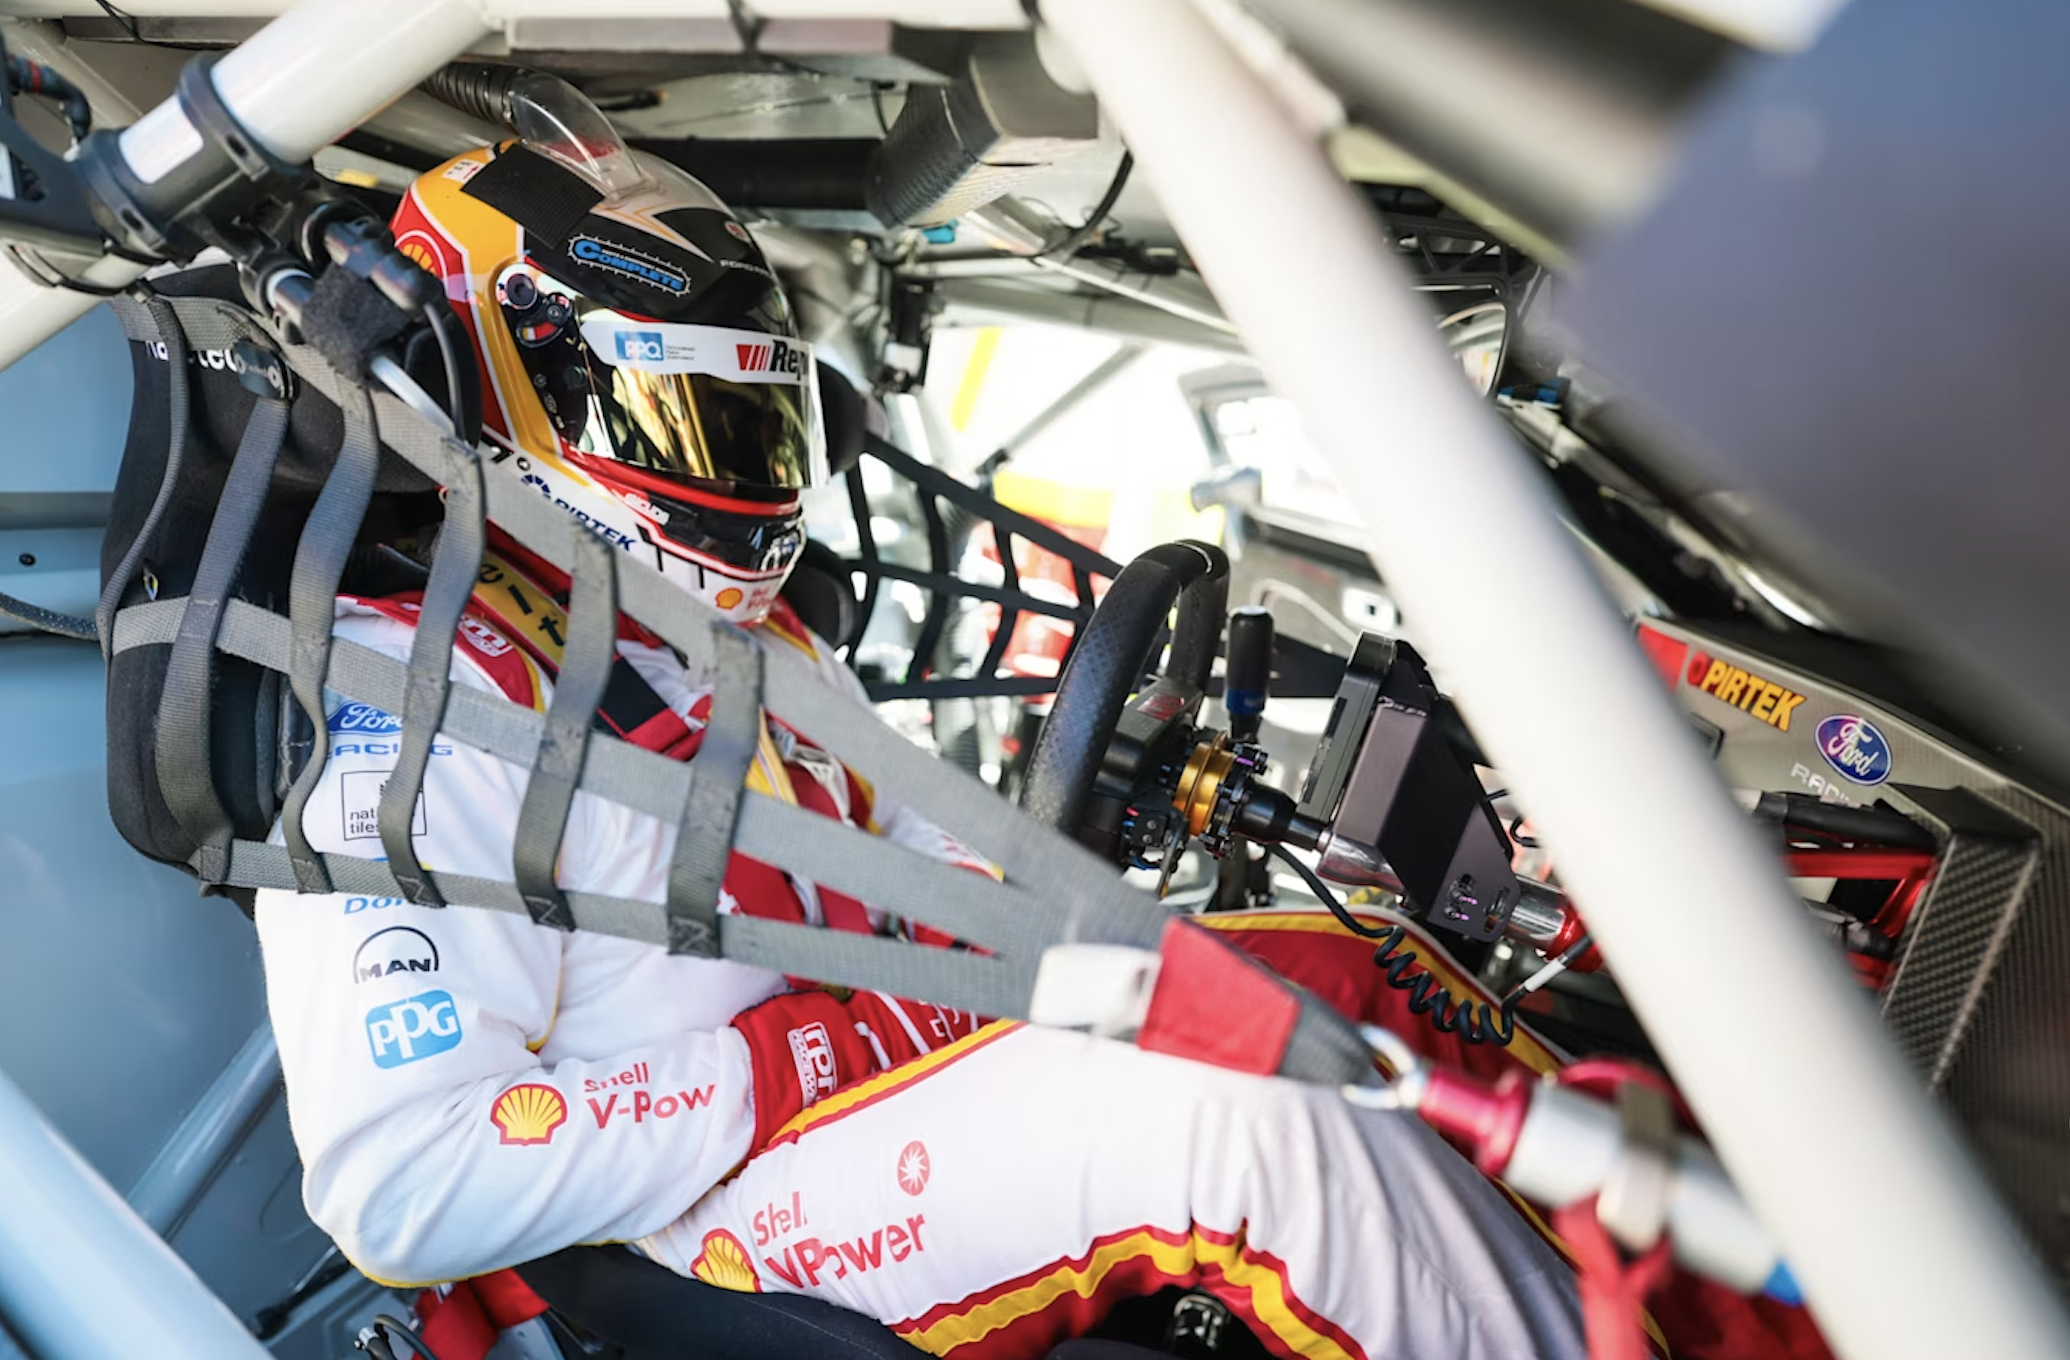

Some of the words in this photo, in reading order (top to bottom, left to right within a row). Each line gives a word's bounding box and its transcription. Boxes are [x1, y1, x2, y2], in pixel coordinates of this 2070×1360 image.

[574, 239, 685, 291] COMPLETE
[1701, 658, 1806, 732] PIRTEK
[1827, 722, 1880, 777] Ford
[359, 958, 431, 982] MAN
[369, 1000, 458, 1059] PPG
[753, 1191, 808, 1247] Shel
